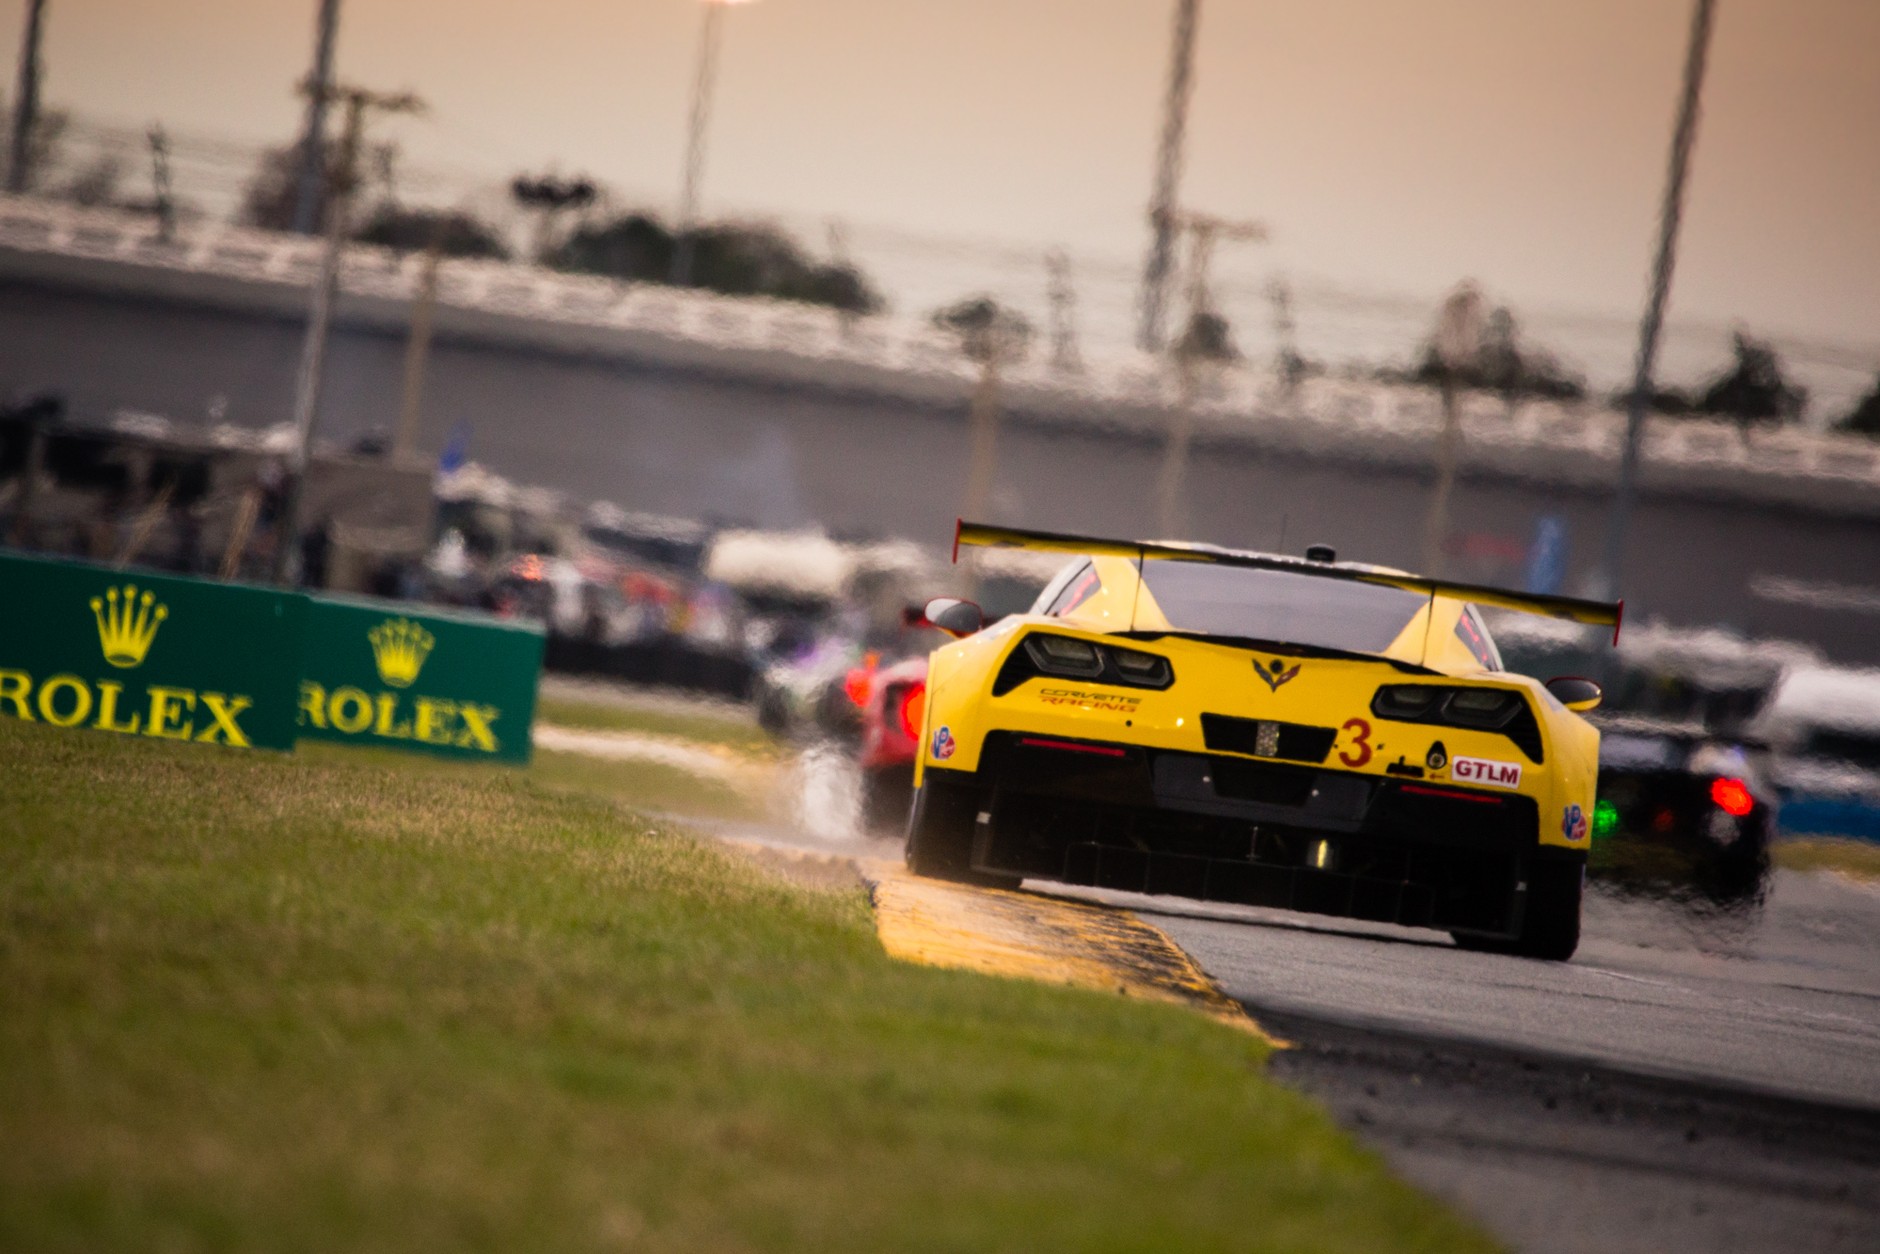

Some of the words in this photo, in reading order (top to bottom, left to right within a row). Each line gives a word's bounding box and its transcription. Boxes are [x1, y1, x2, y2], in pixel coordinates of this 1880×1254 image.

[0, 669, 252, 748] ROLEX
[1040, 688, 1142, 705] CORVETTE
[1041, 696, 1137, 713] RACING
[298, 680, 499, 752] ROLEX
[1339, 718, 1372, 768] 3
[1455, 759, 1519, 784] GTLM
